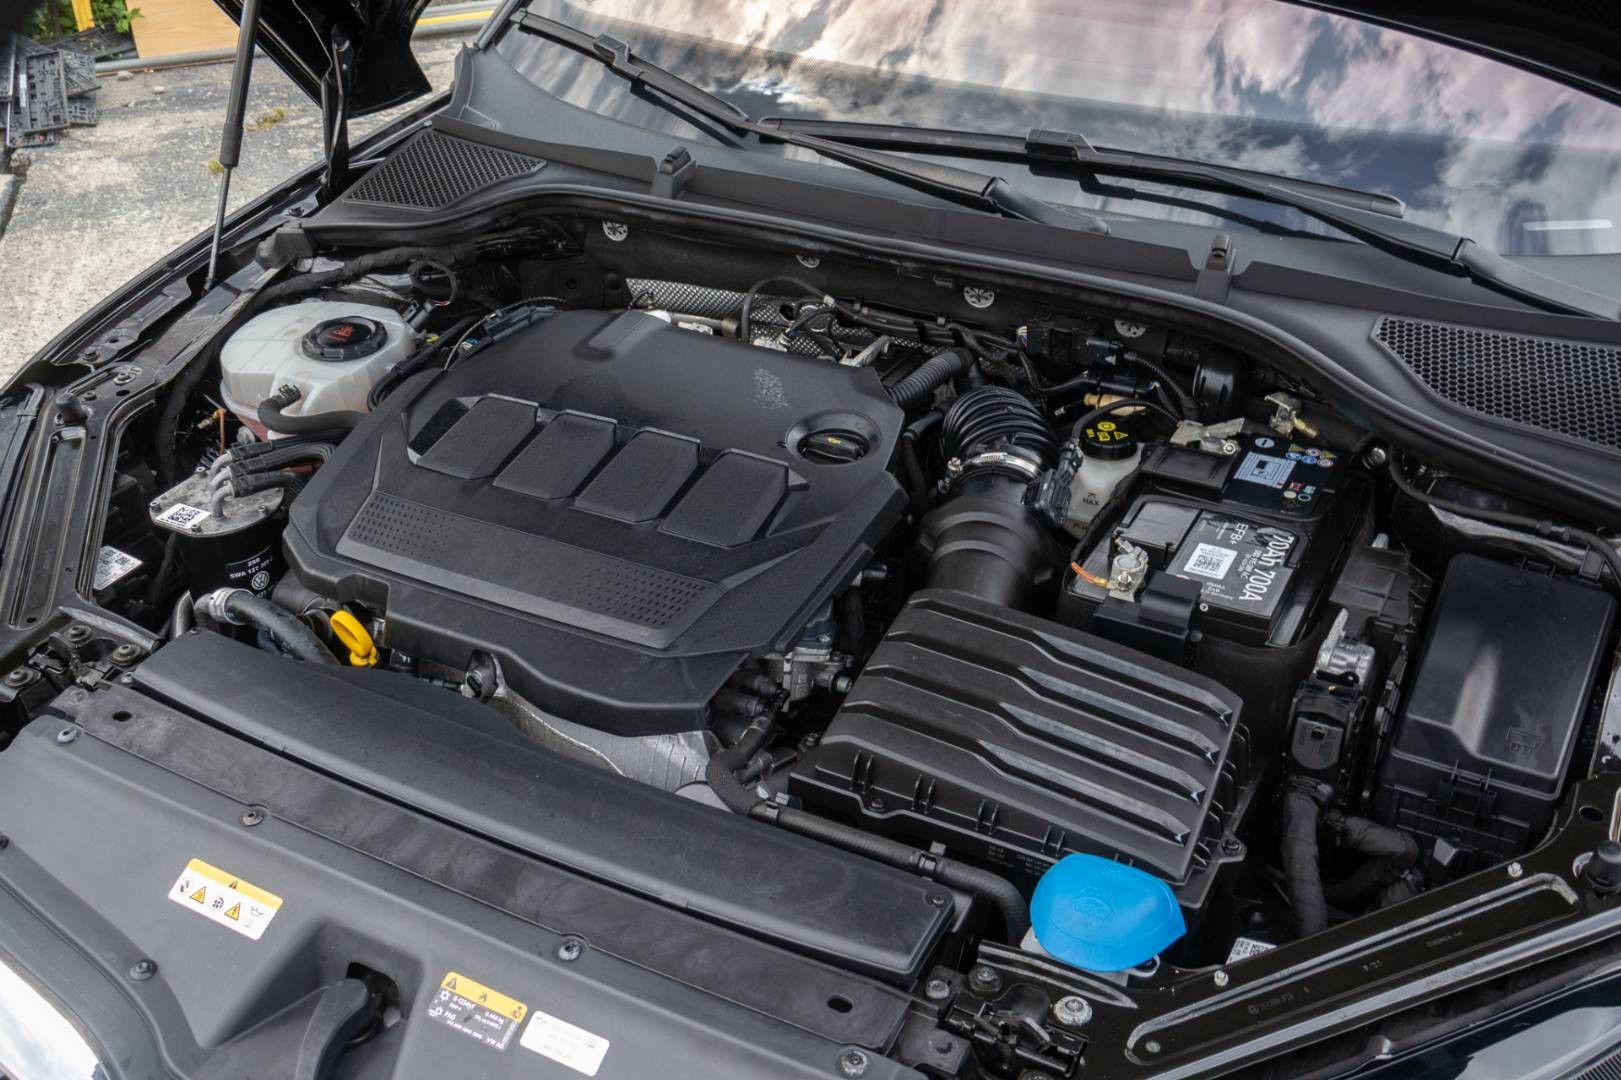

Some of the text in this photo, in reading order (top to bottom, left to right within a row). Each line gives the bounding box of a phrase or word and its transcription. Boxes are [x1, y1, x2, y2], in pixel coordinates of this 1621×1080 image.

[1082, 497, 1099, 506] MAX
[1230, 522, 1249, 545] EFB+
[1258, 534, 1295, 567] 70Ah
[1238, 568, 1277, 600] 700A
[444, 1010, 457, 1021] PAG
